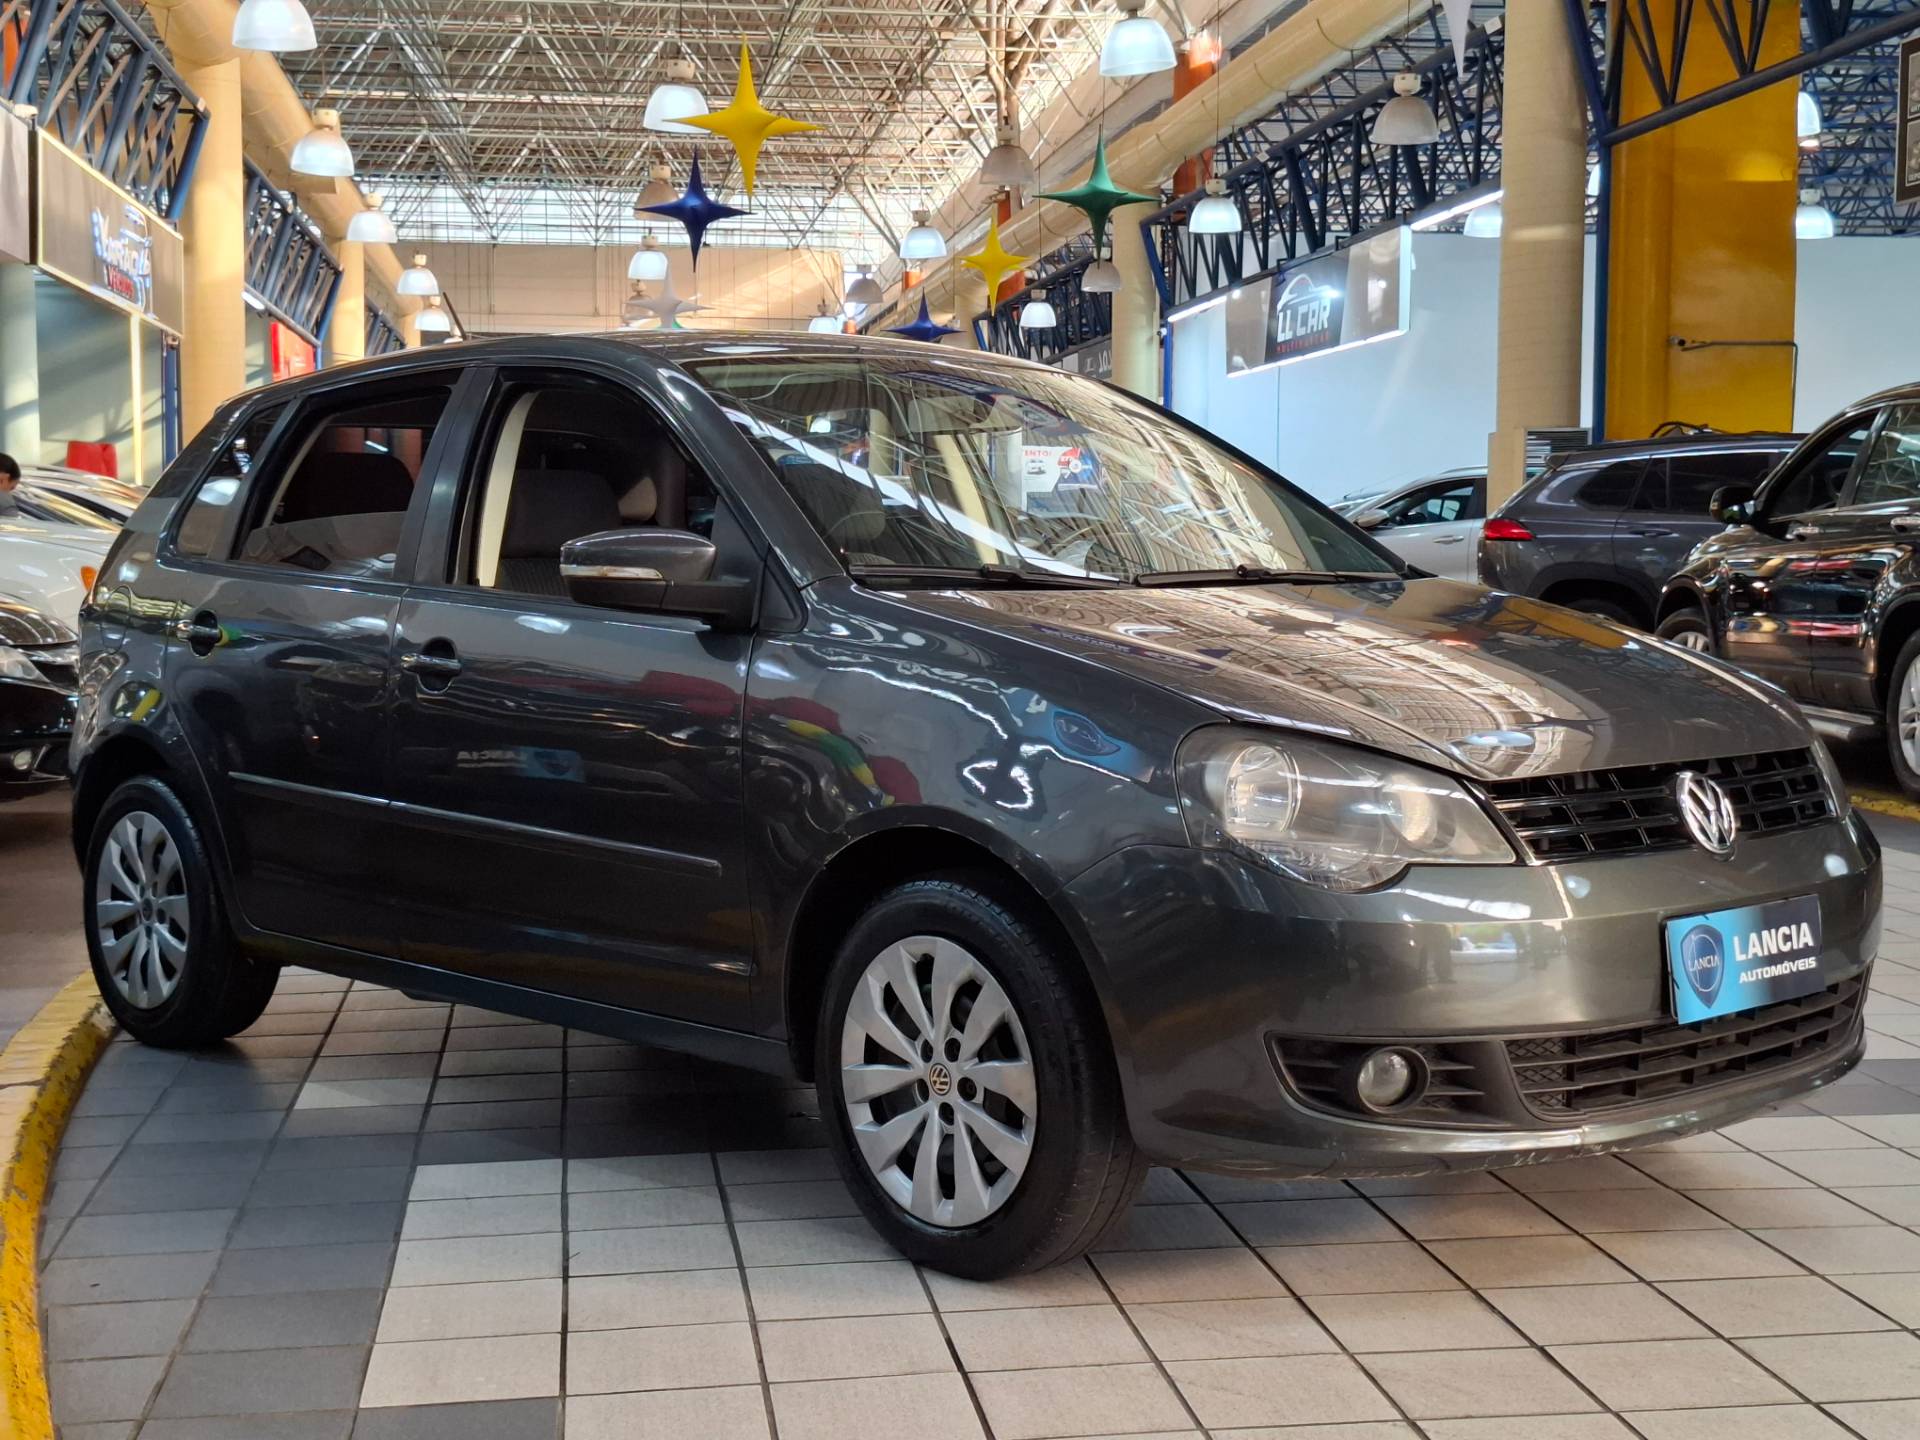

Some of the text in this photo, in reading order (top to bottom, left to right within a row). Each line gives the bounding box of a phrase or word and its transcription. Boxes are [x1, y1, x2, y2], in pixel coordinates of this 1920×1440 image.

[1277, 298, 1331, 343] LL CAR
[1733, 922, 1815, 962] LANCIA
[1688, 954, 1720, 972] LANCIA
[1739, 956, 1817, 984] AUTOMÓVEIS
